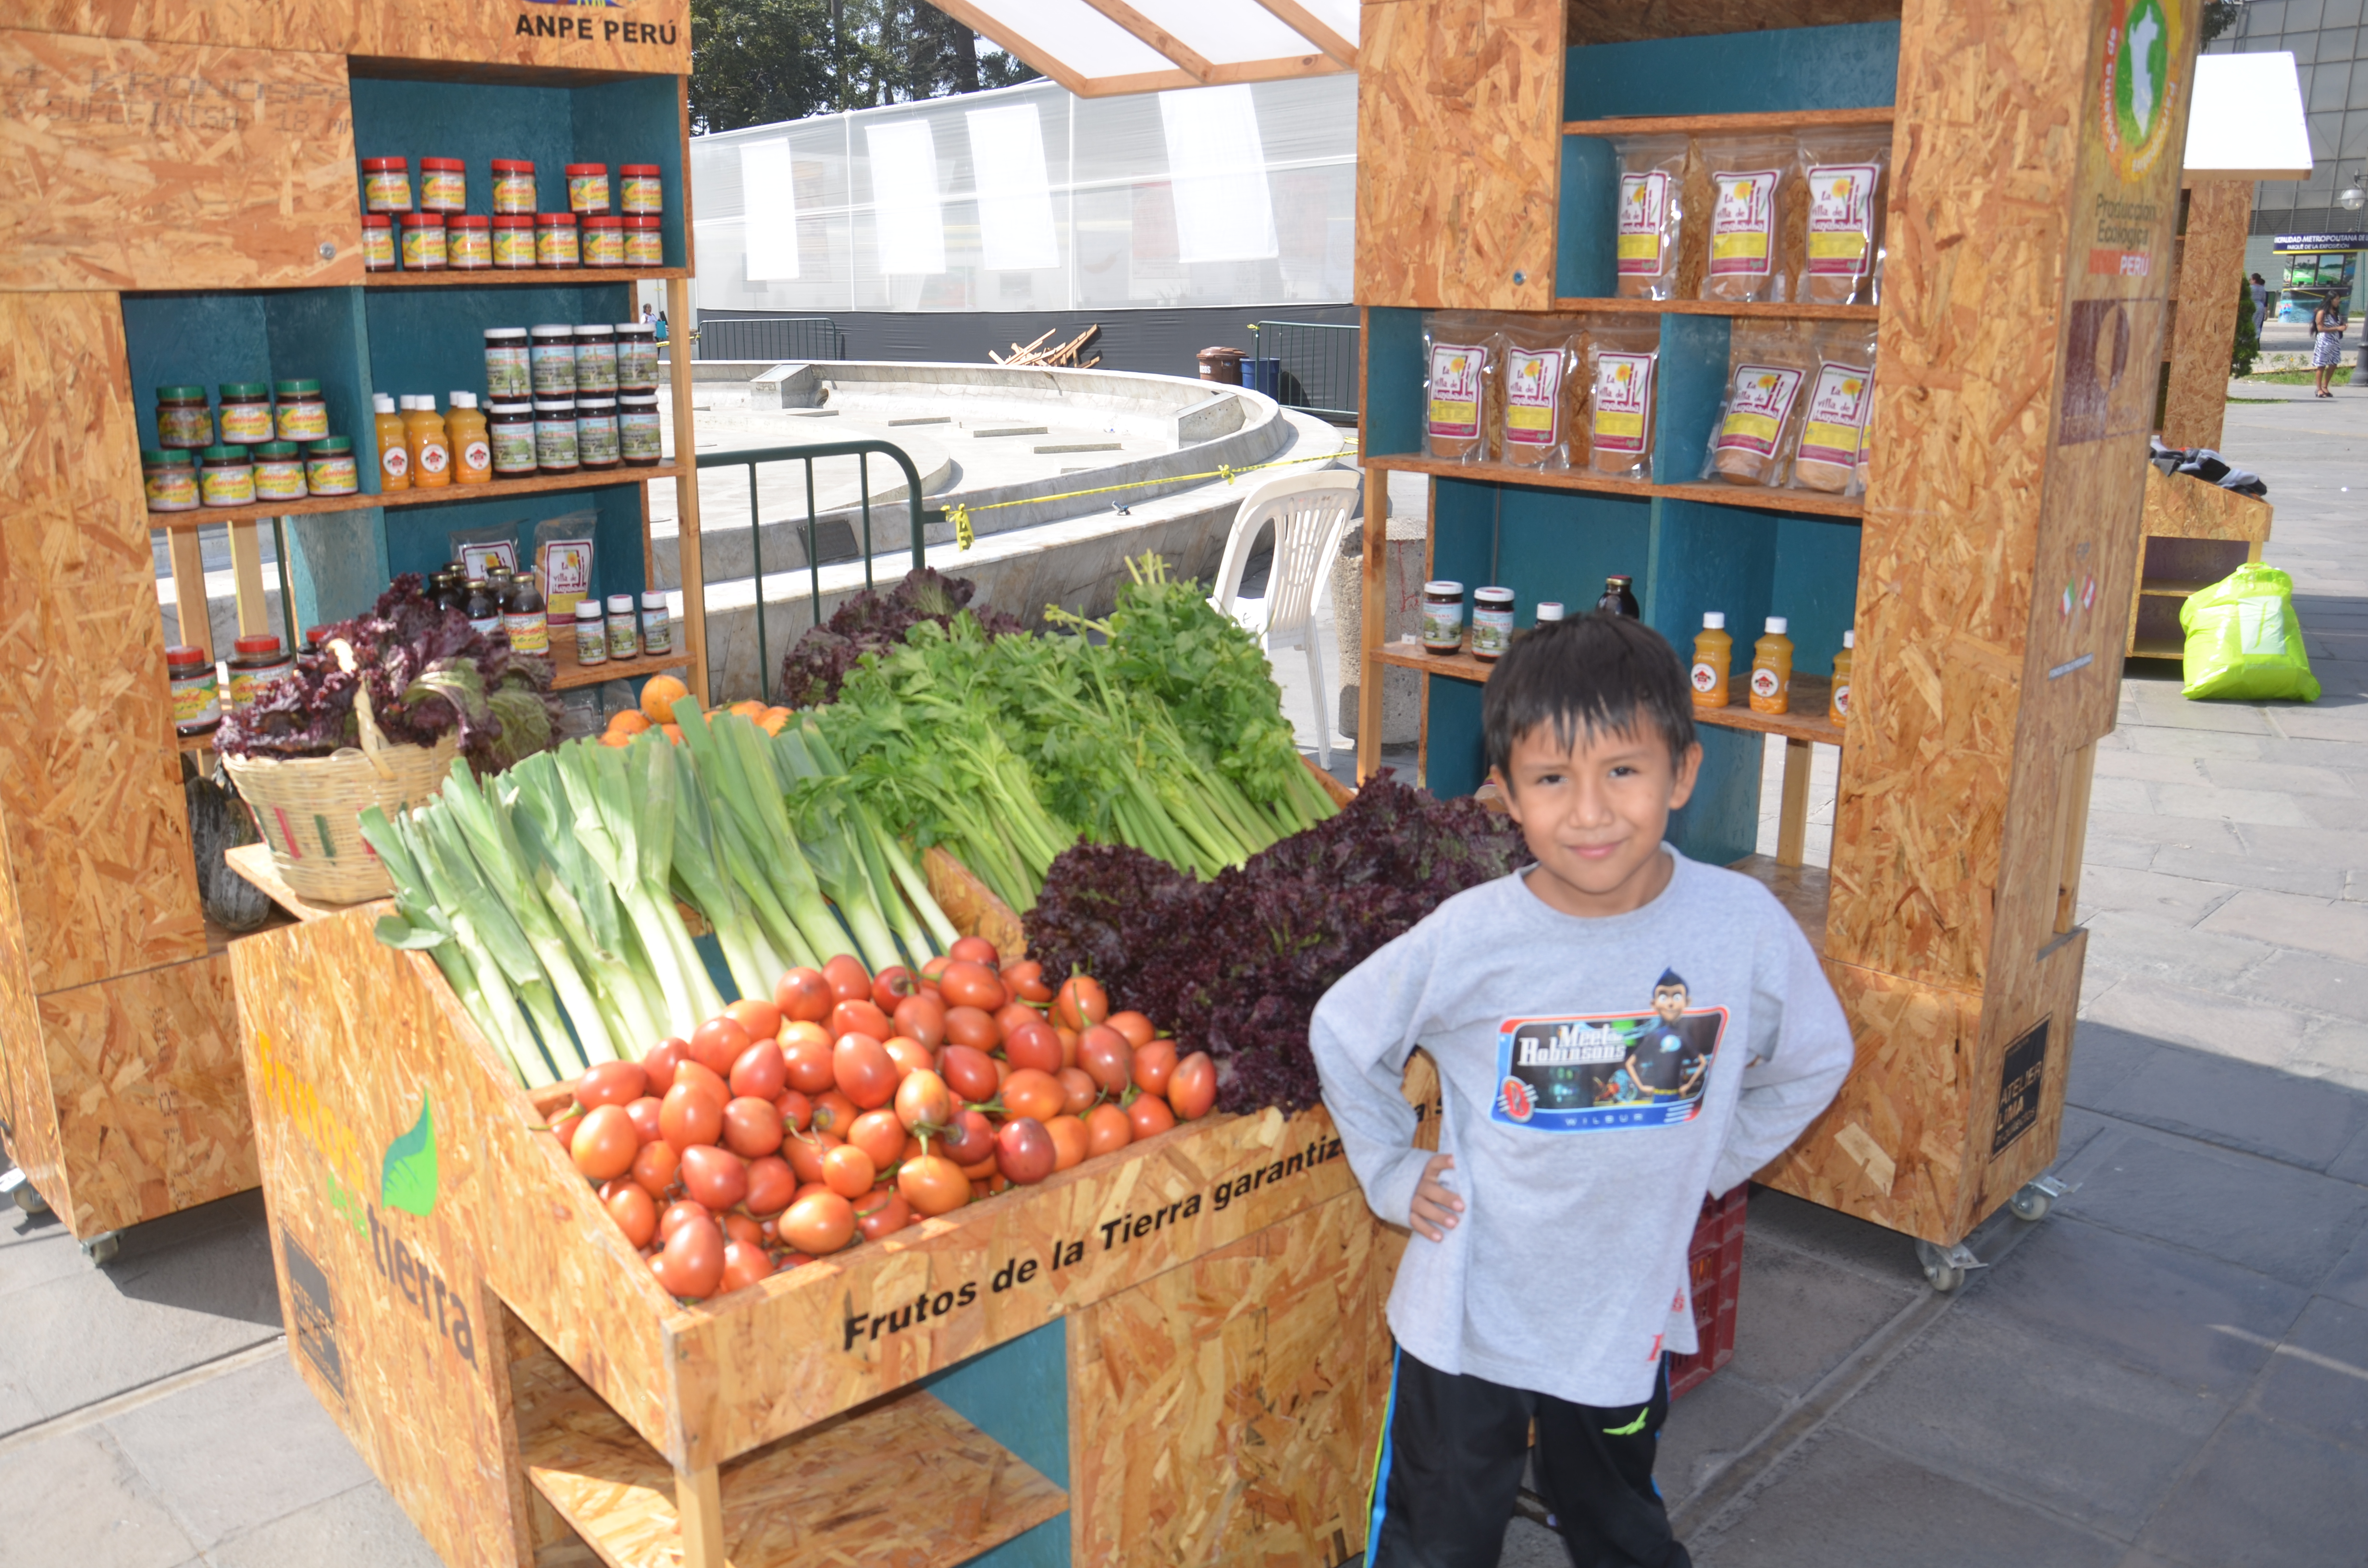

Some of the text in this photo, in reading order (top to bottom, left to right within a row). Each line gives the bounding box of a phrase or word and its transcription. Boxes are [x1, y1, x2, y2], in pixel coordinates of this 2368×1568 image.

[516, 14, 677, 45] ANPE PERÚ
[1736, 208, 1745, 217] de
[1832, 206, 1843, 216] de
[2096, 193, 2156, 221] Producción
[2097, 219, 2149, 250] Ecológica
[2302, 234, 2357, 243] METROPOLITANA
[2120, 253, 2150, 277] PERÚ
[1450, 380, 1458, 389] de
[1525, 383, 1534, 393] de
[1615, 389, 1624, 398] de
[1754, 393, 1764, 402] de
[1817, 398, 1850, 412] villa de
[561, 562, 569, 571] La
[553, 574, 568, 582] villa
[1559, 1023, 1611, 1047] Meet
[1517, 1036, 1627, 1066] Robinsons
[2000, 1061, 2042, 1108] ATELIER
[1565, 1113, 1644, 1127] WILBUR
[1997, 1095, 2025, 1131] LIMA
[844, 1134, 1344, 1350] Frutos de la Tierra garantiz
[368, 1202, 479, 1372] tierra
